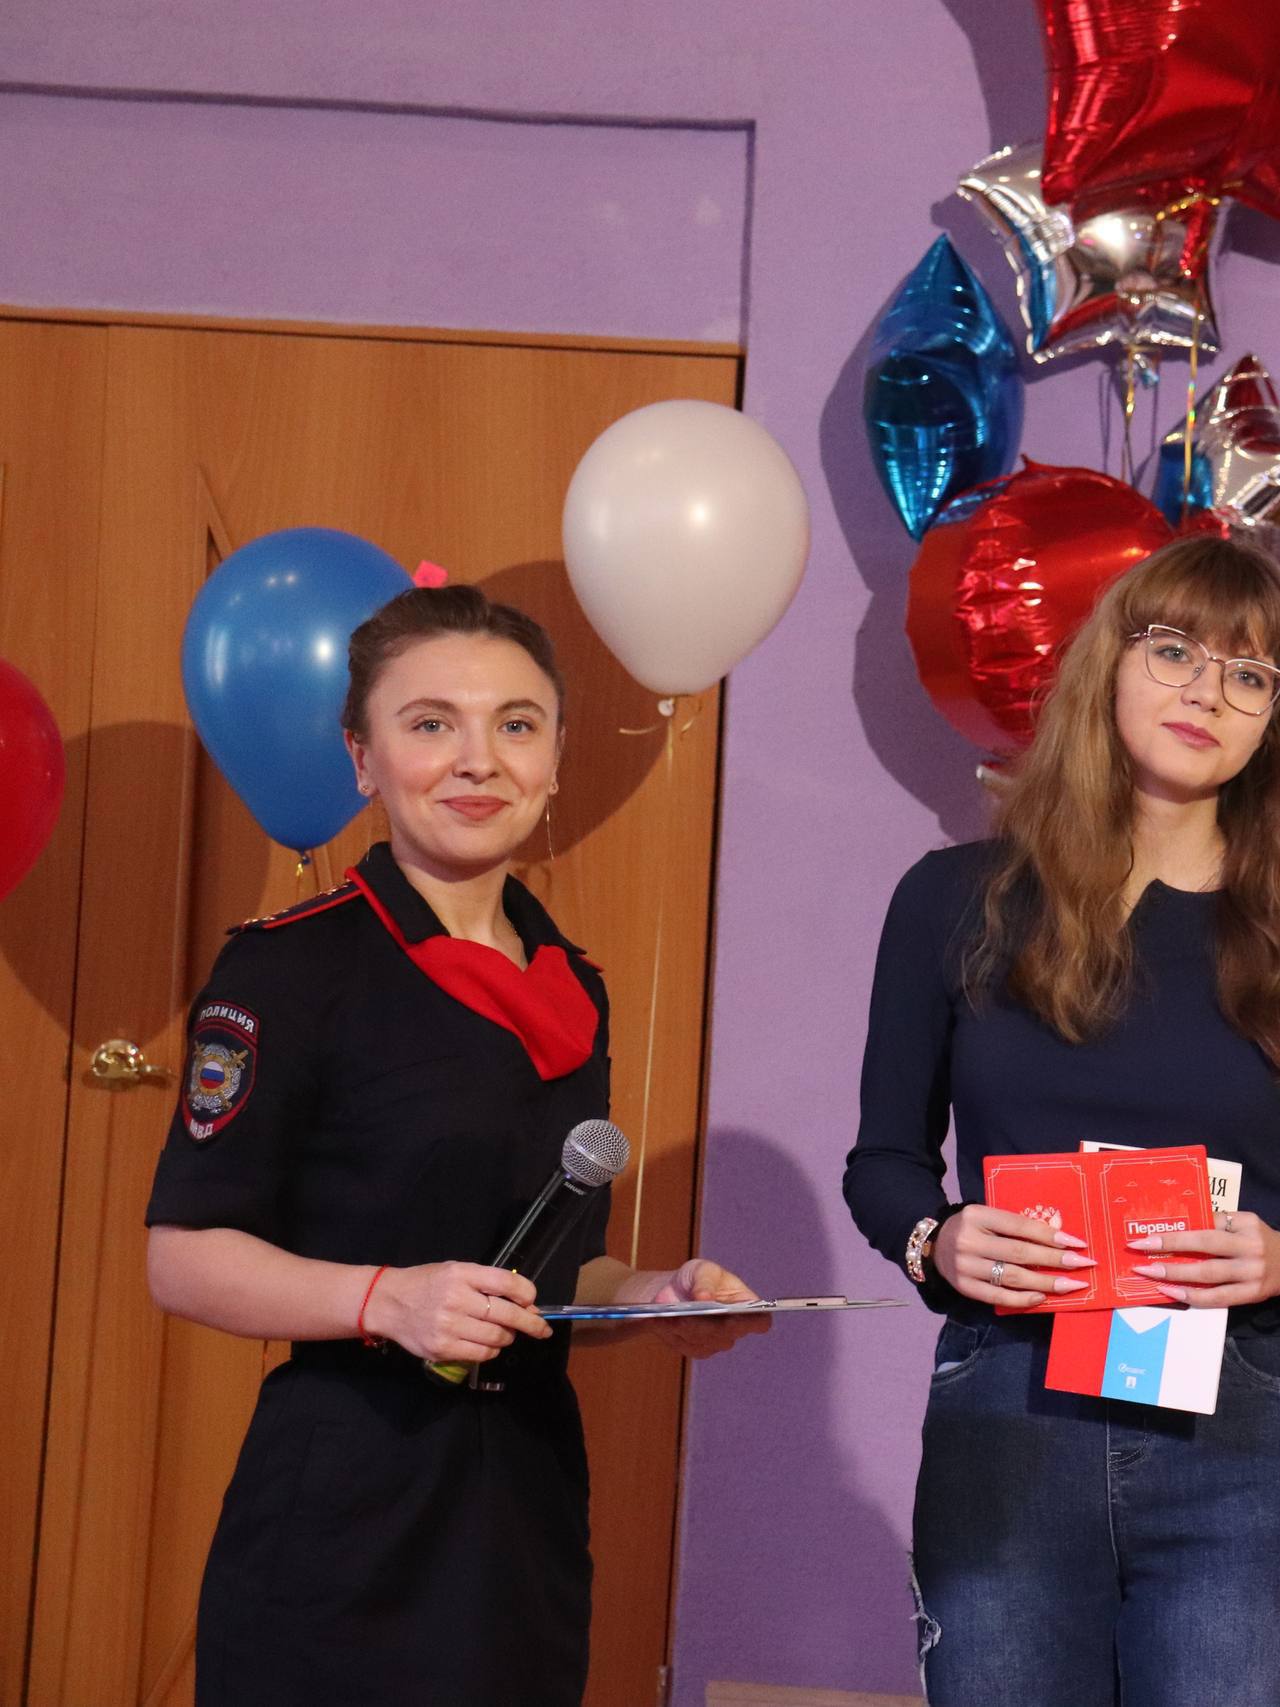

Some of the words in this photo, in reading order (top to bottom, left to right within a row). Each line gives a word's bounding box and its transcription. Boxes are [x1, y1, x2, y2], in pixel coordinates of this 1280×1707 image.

[200, 1005, 255, 1034] ПОЛИЦИЯ
[188, 1117, 214, 1140] МВД
[1128, 1221, 1186, 1236] Первые
